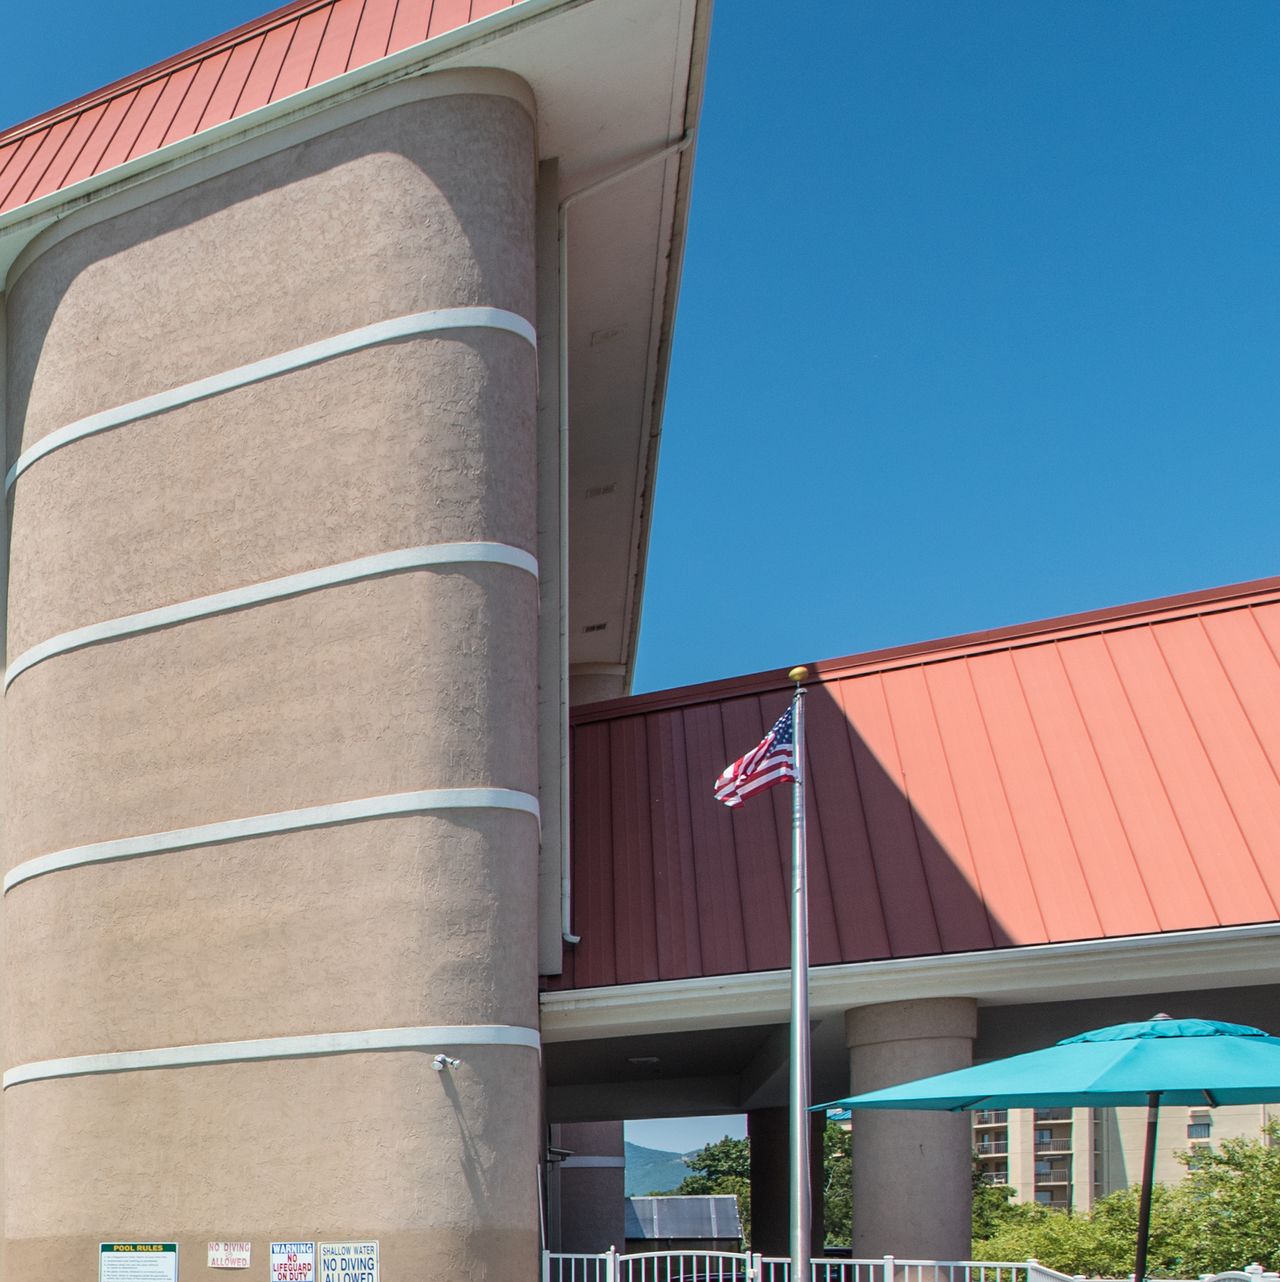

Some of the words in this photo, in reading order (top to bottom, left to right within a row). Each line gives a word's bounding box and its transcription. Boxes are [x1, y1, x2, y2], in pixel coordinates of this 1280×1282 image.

[209, 1242, 220, 1252] NO
[224, 1242, 250, 1252] DIVING
[272, 1244, 312, 1254] WARNING
[322, 1246, 351, 1256] SHALLOW
[354, 1245, 375, 1255] WATER
[211, 1257, 248, 1266] ALLOWED
[287, 1254, 298, 1263] NO
[273, 1263, 312, 1272] LIFEGUARD
[323, 1258, 337, 1271] NO
[341, 1257, 375, 1271] DIVING
[277, 1272, 288, 1281] ON
[289, 1272, 308, 1281] DUTY
